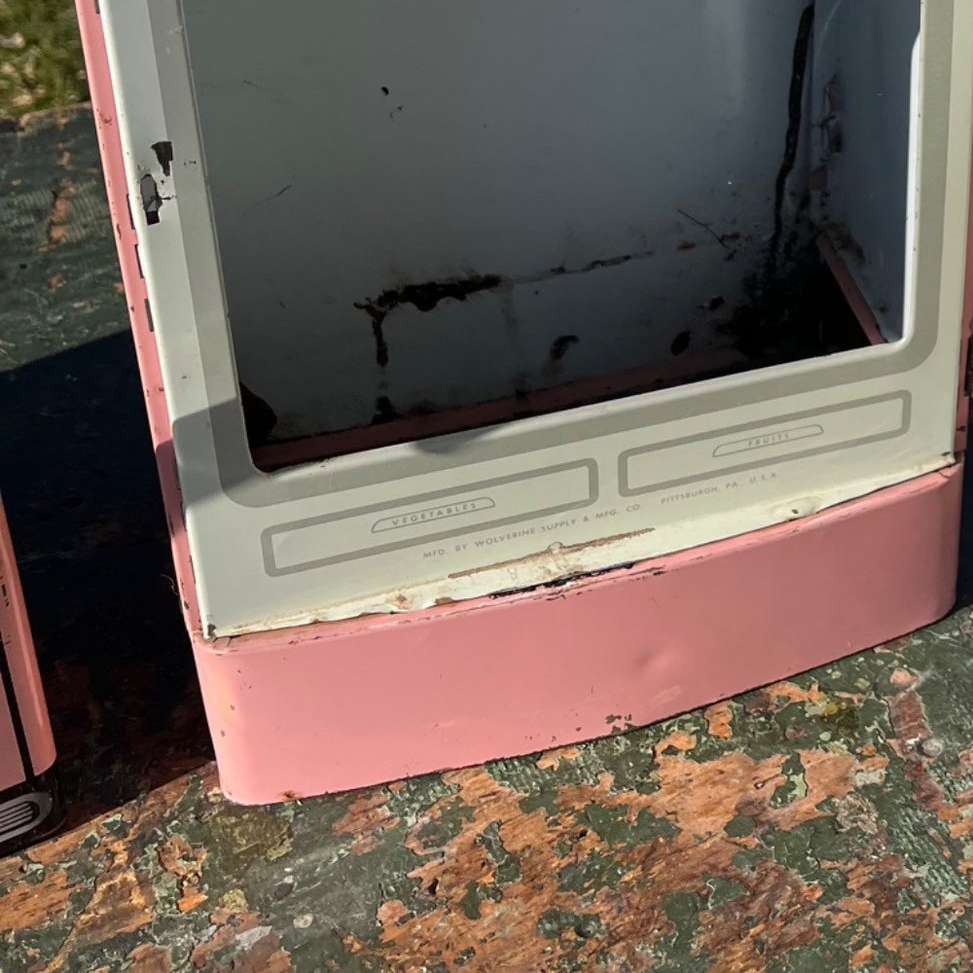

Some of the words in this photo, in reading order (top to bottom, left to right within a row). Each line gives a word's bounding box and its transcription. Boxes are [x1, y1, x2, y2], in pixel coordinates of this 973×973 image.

[748, 433, 790, 446] FRUITS
[392, 503, 476, 525] VEGETABLES
[455, 543, 467, 552] BY
[474, 527, 535, 547] WOLVERINE
[541, 518, 576, 533] SUPPLY
